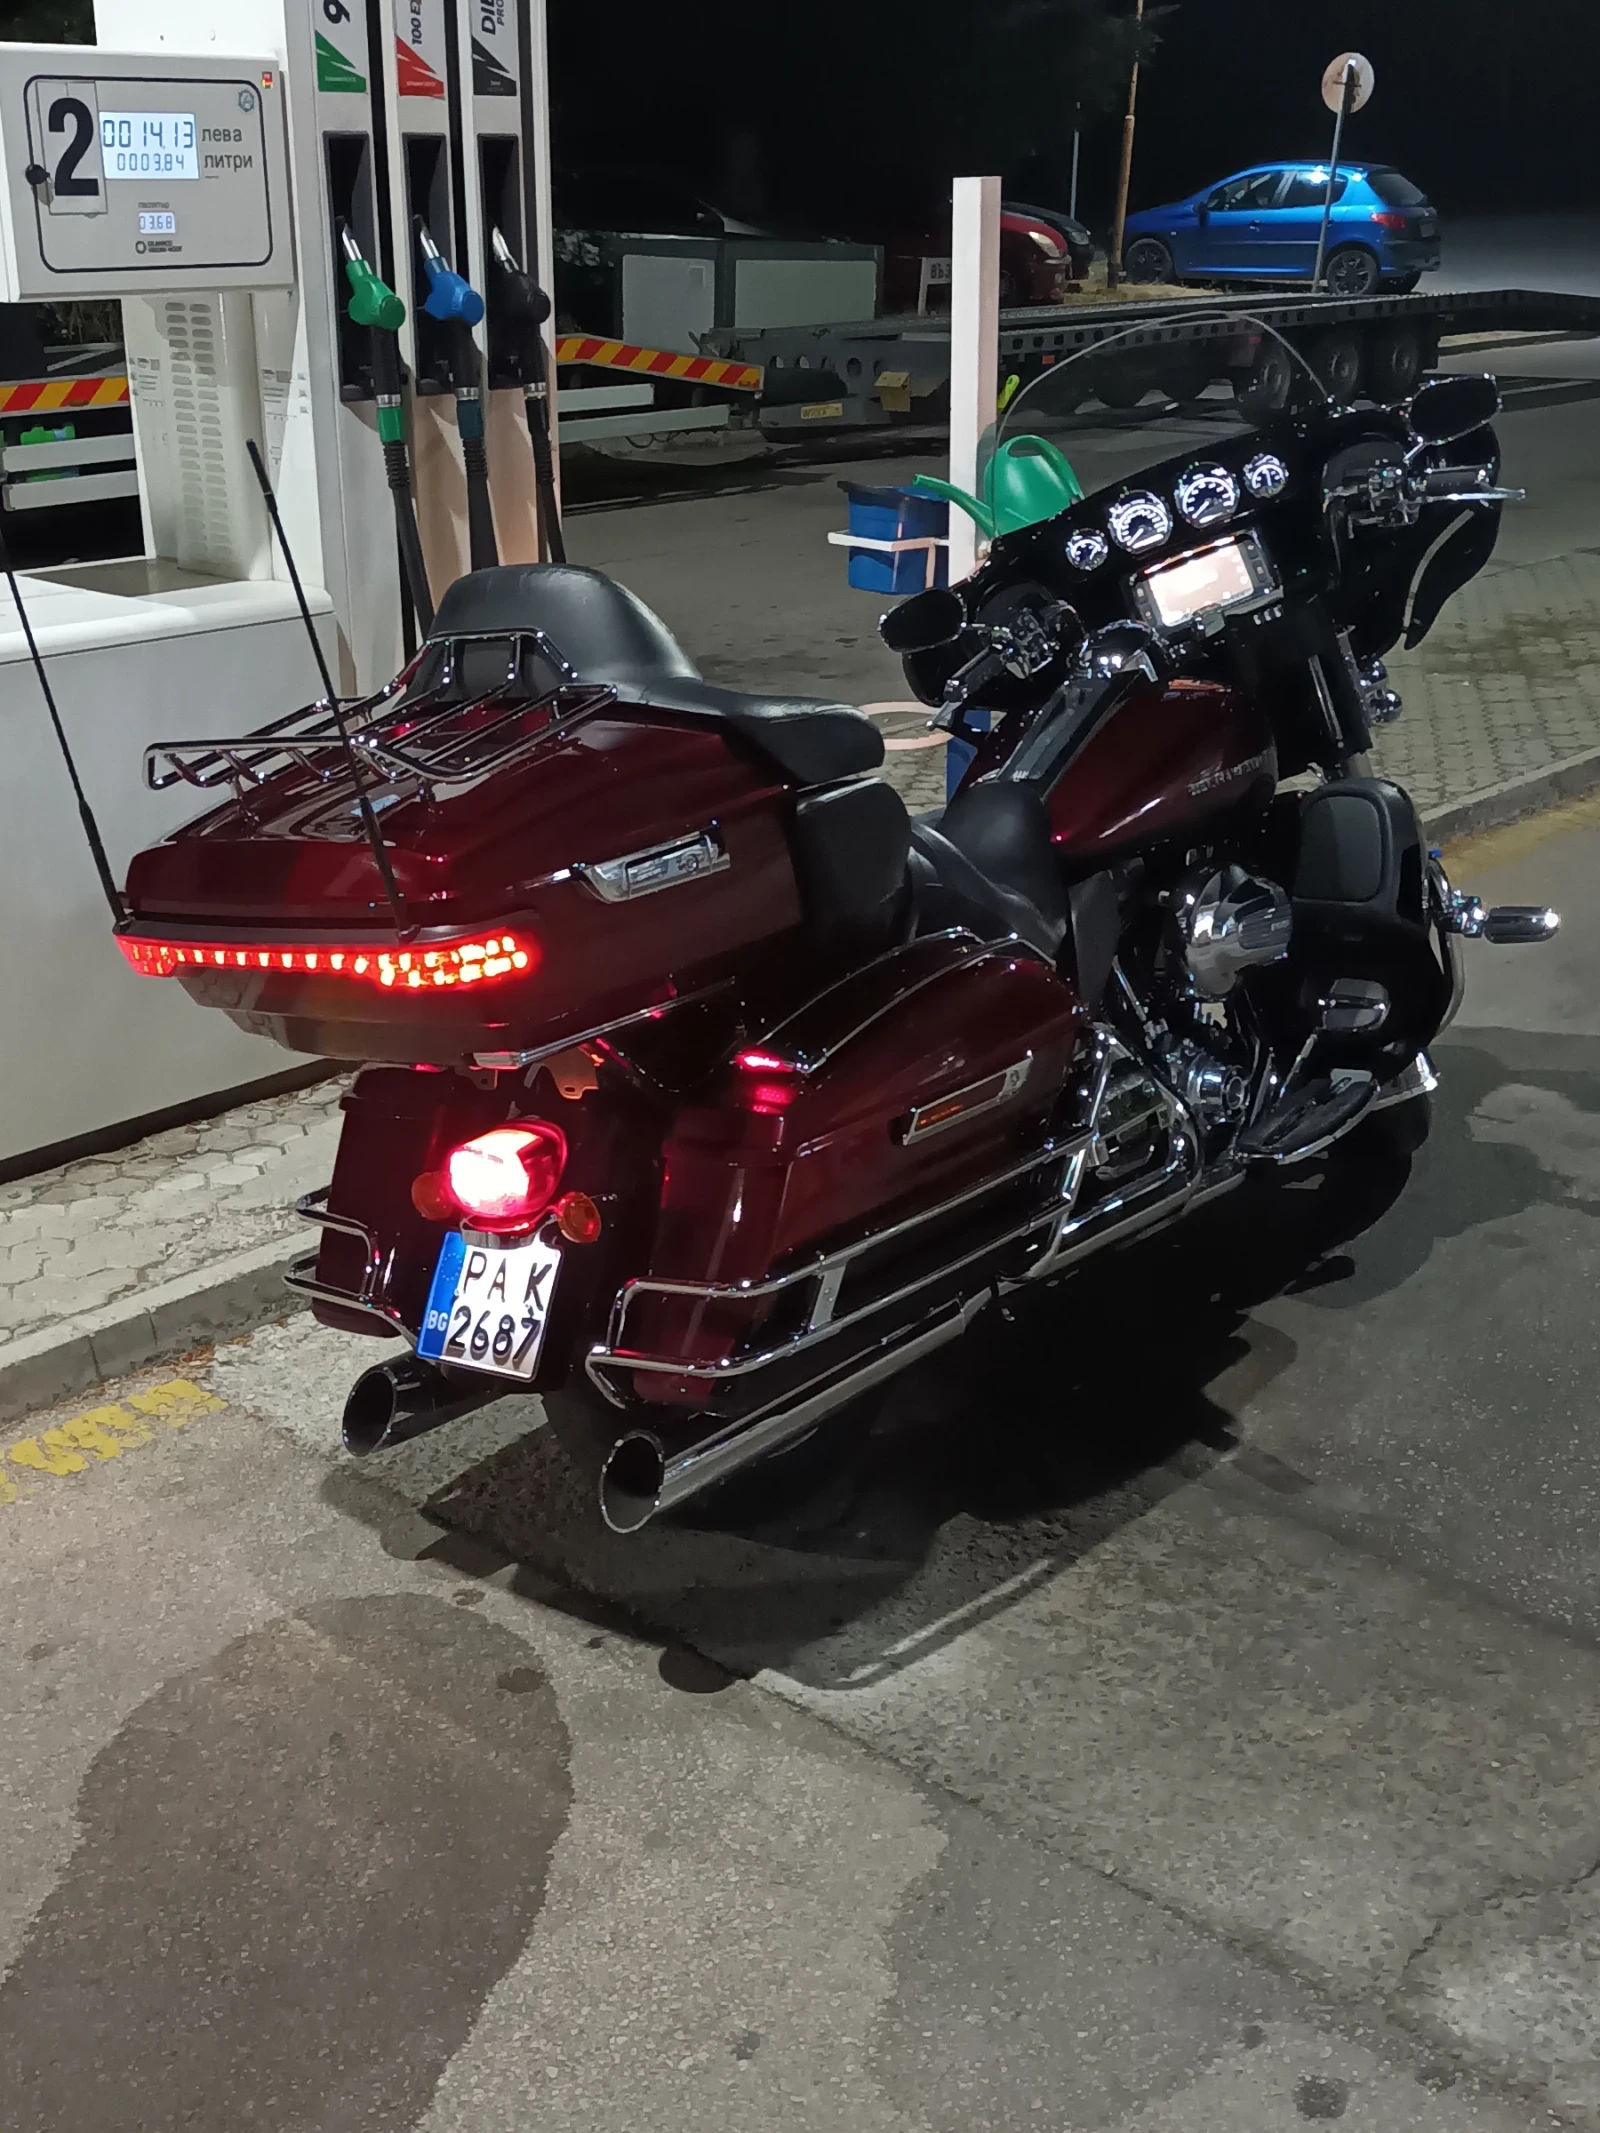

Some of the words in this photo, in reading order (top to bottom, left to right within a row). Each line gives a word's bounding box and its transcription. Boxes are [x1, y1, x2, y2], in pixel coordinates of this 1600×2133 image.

[410, 17, 423, 45] 100
[48, 97, 100, 196] 2
[201, 127, 243, 142] лева
[203, 153, 254, 173] литри
[427, 1309, 448, 1331] BG
[447, 1304, 542, 1362] 2687
